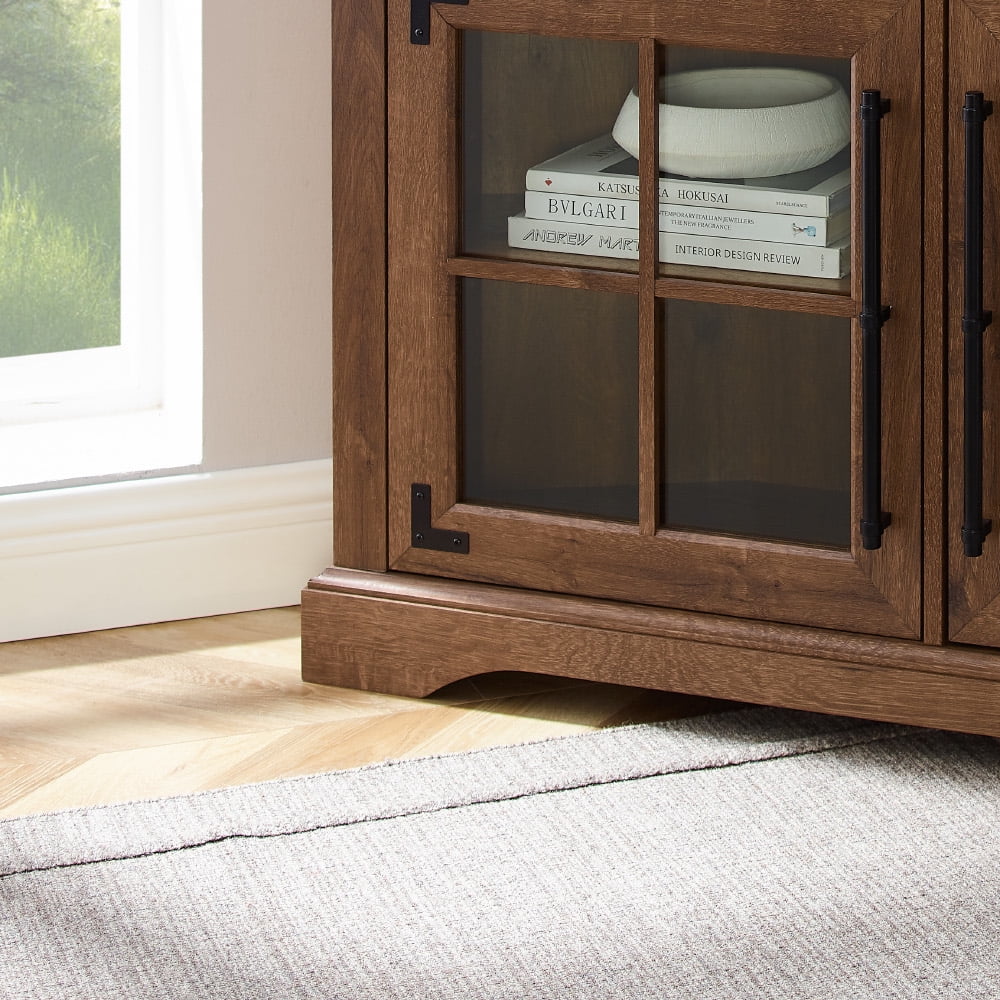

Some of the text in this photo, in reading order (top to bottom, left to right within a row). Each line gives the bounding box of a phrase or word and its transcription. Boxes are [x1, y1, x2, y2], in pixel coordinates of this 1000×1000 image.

[678, 188, 729, 204] HOKUSAI
[548, 198, 627, 221] BVLGARI
[698, 222, 732, 231] FRAGRANCE
[522, 228, 594, 246] ANDREW
[675, 244, 801, 265] INTERIOR DESIGN REVIEW
